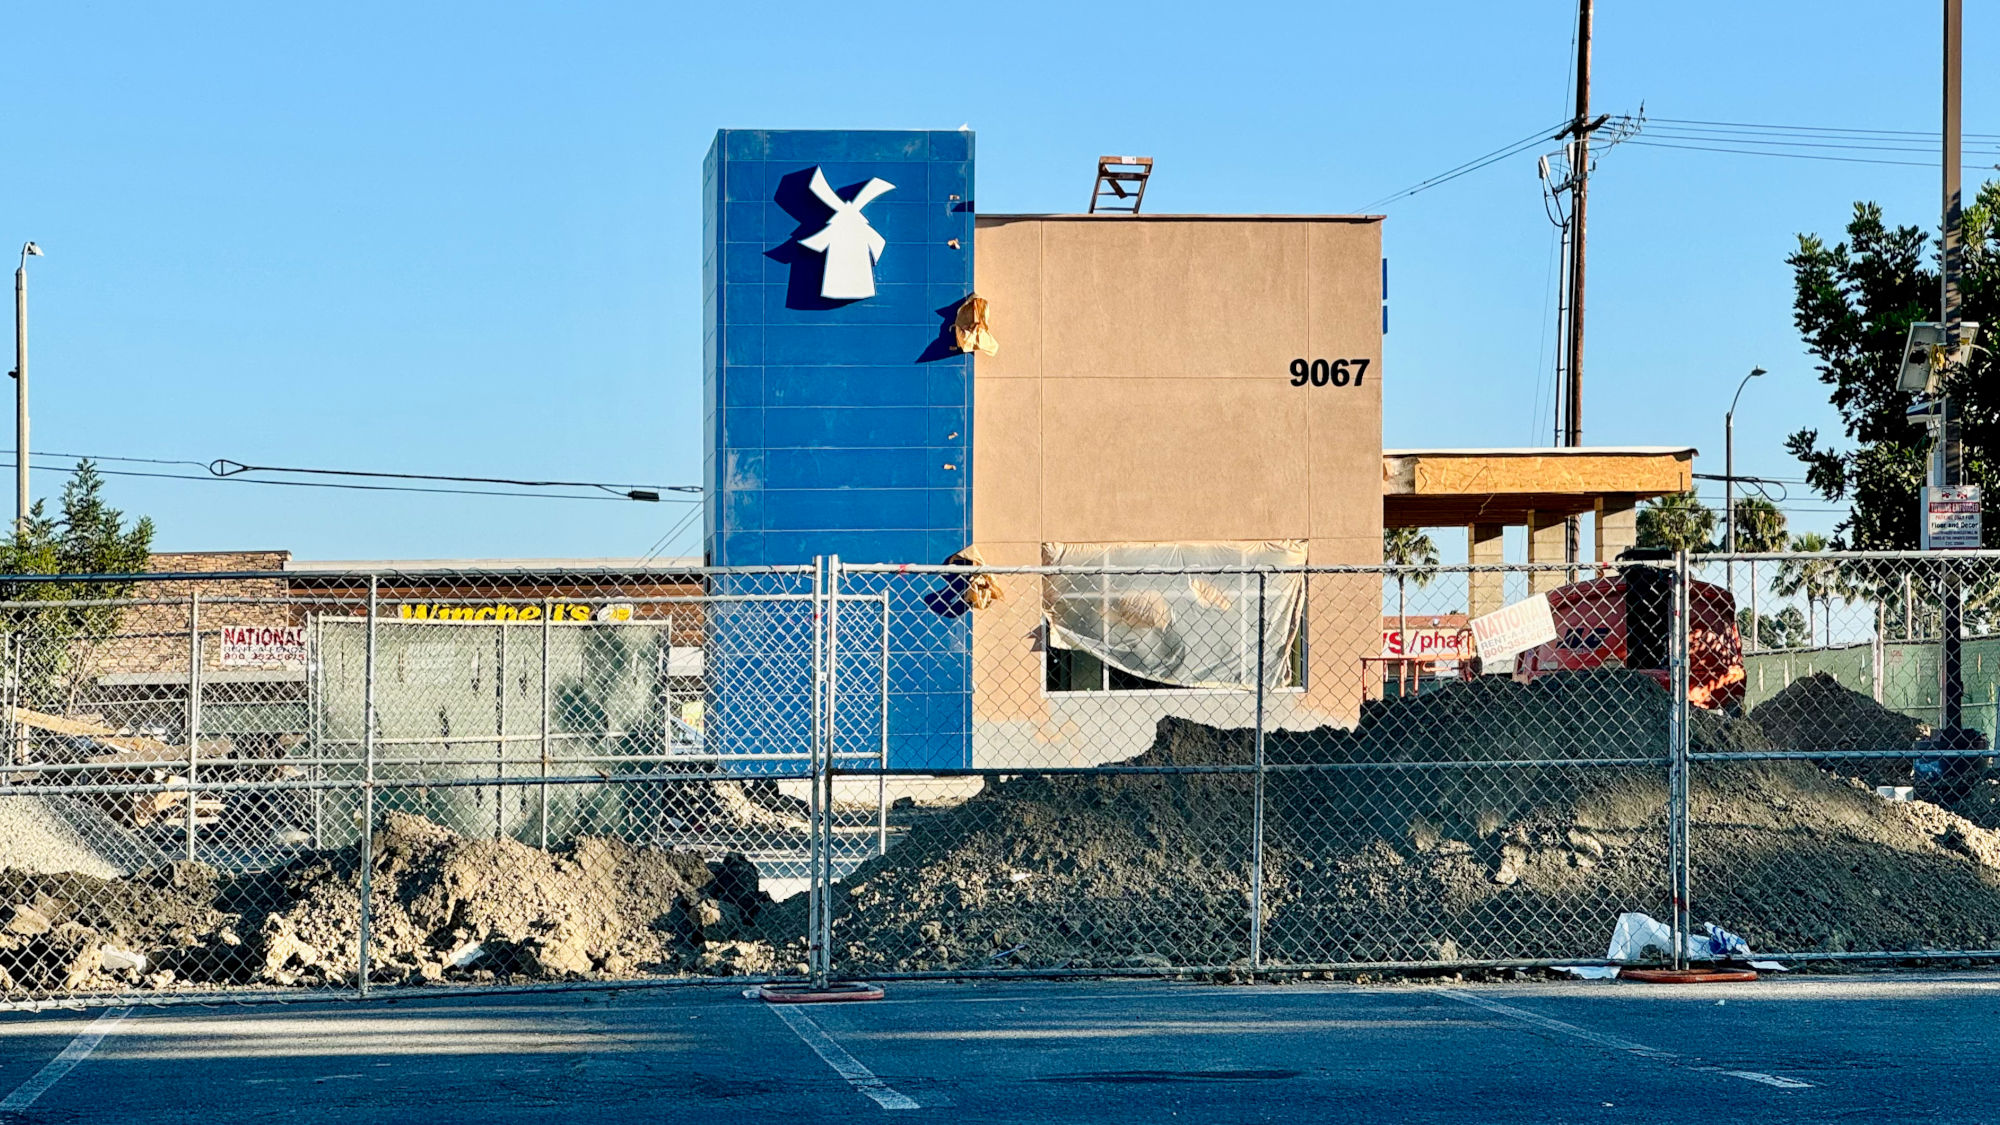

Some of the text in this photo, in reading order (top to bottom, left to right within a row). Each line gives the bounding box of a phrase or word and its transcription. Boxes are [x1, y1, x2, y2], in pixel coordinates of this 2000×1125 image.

[1290, 359, 1370, 386] 9067
[1474, 598, 1550, 641] NATIONAL
[224, 628, 304, 646] NATIONAL
